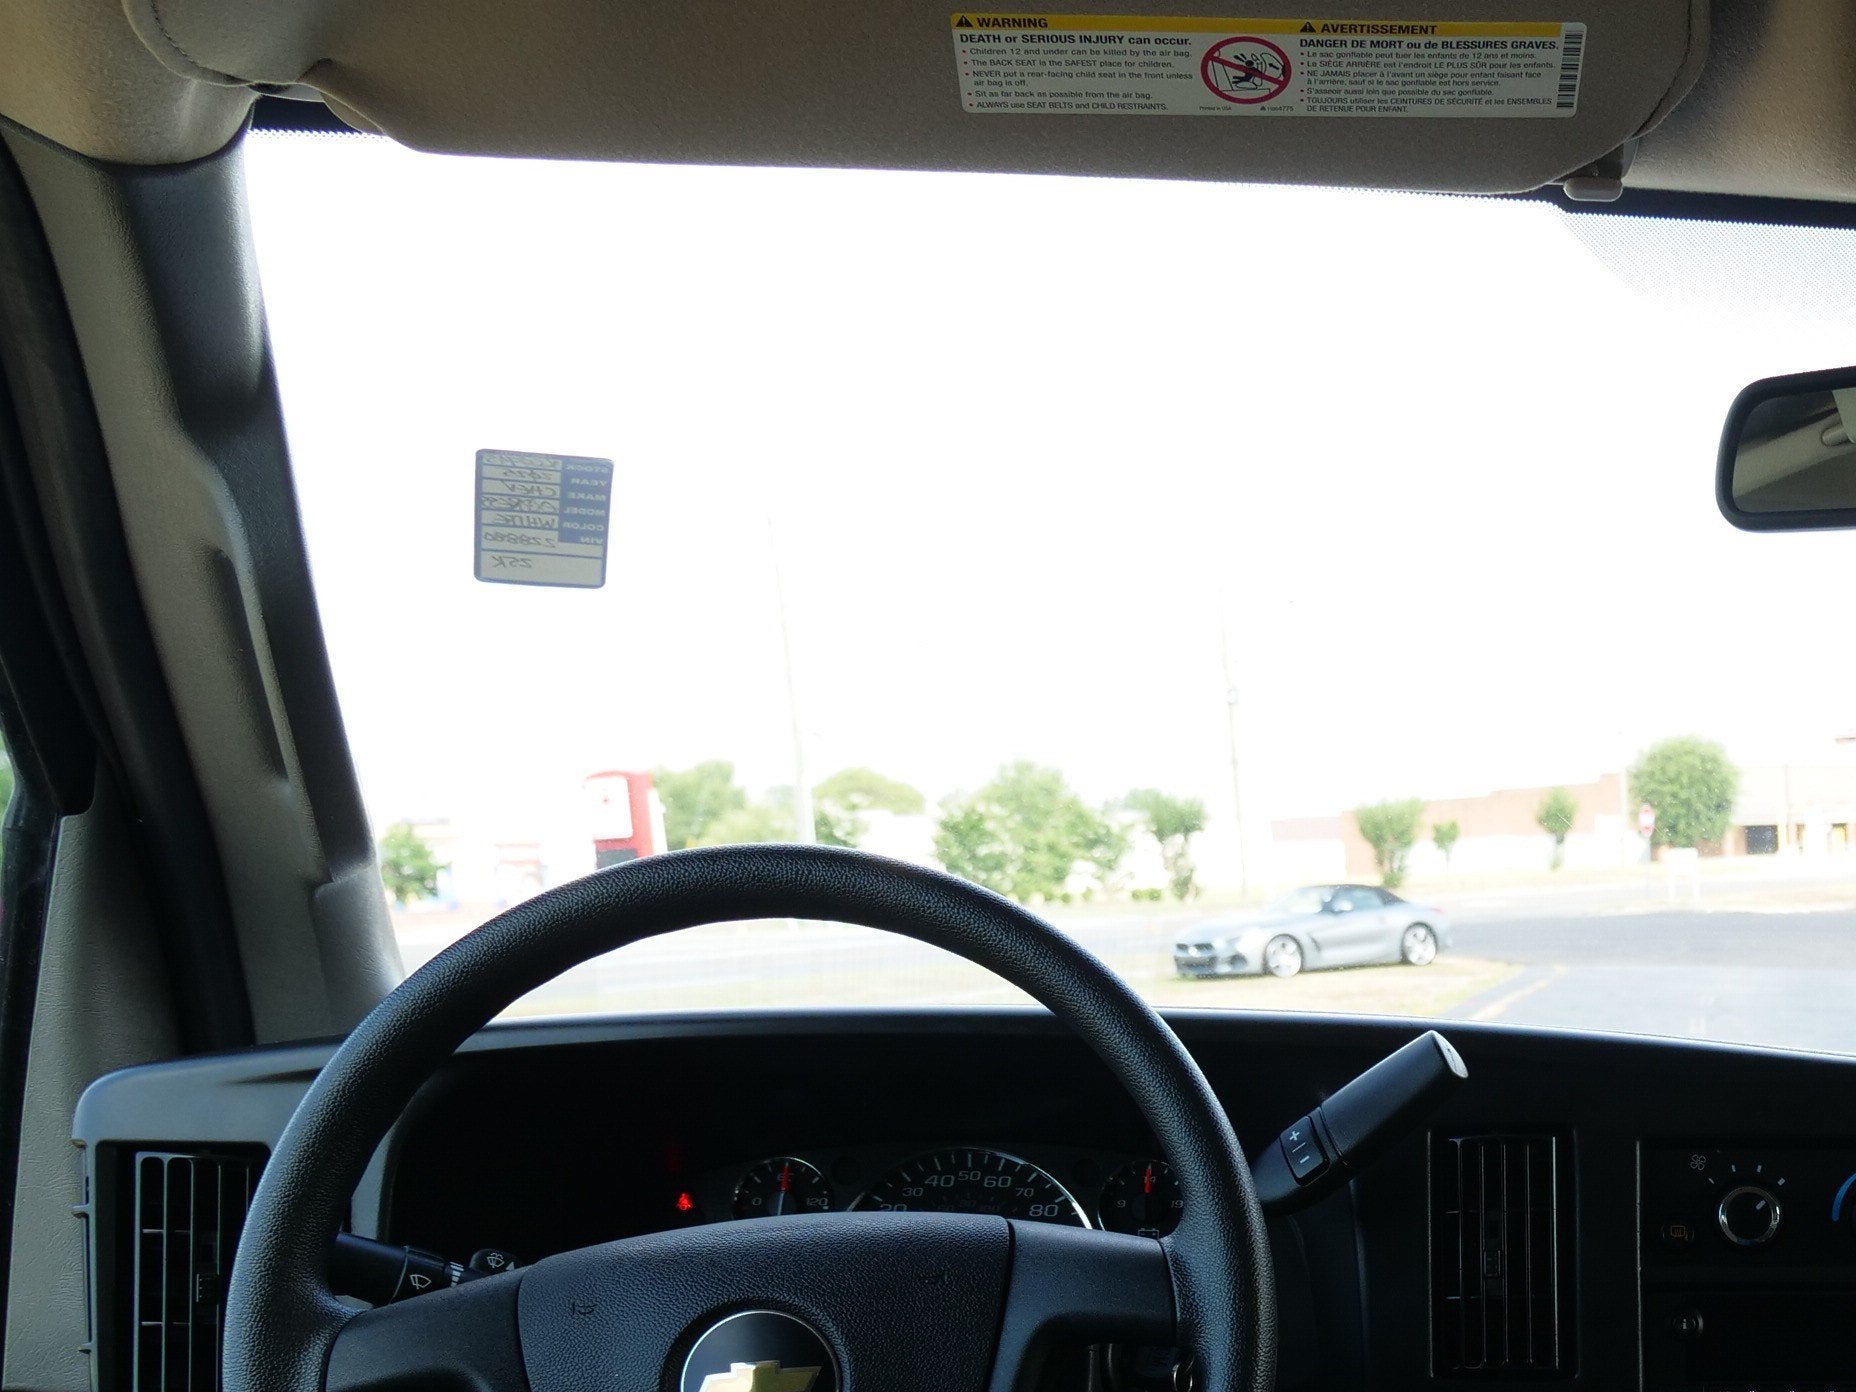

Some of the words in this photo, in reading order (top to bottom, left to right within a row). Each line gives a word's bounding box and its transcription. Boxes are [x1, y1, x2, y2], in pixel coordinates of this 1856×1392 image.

[976, 17, 1048, 27] WARNING
[1321, 23, 1437, 35] AVERTISSEMENT
[959, 33, 1001, 43] DEATH
[1004, 35, 1018, 43] or
[1020, 34, 1076, 44] SERIOUS
[1079, 34, 1124, 44] INJURY
[1154, 37, 1191, 45] occur.
[1299, 38, 1347, 48] DANGER
[1351, 39, 1366, 48] DE
[1369, 39, 1404, 49] MORT
[1406, 41, 1421, 49] ou
[1423, 40, 1438, 49] de
[1441, 39, 1508, 50] BLESSURES
[1510, 40, 1559, 49] GRAVES.
[969, 47, 1007, 55] Children
[1023, 47, 1040, 55] and
[1103, 48, 1127, 56] killed
[1129, 48, 1140, 57] by
[1173, 49, 1192, 58] bag.
[989, 58, 1013, 66] BACK
[1138, 60, 1174, 68] children.
[972, 69, 1001, 77] NEVER
[1002, 70, 1017, 78] put
[1026, 70, 1073, 78] rear-facing
[1075, 70, 1096, 78] child
[986, 79, 1003, 87] bag
[1048, 90, 1083, 98] possible
[1134, 92, 1153, 100] bag.
[1024, 101, 1047, 109] SEAT
[1048, 101, 1073, 109] BELTS
[1091, 101, 1116, 109] CHILD
[1117, 102, 1168, 110] RESTRAINTS.
[925, 1175, 955, 1187] 40
[958, 1171, 981, 1181] 50
[983, 1175, 1011, 1188] 60
[902, 1188, 923, 1197] 30
[1016, 1188, 1034, 1197] 70
[1029, 1204, 1059, 1217] 80
